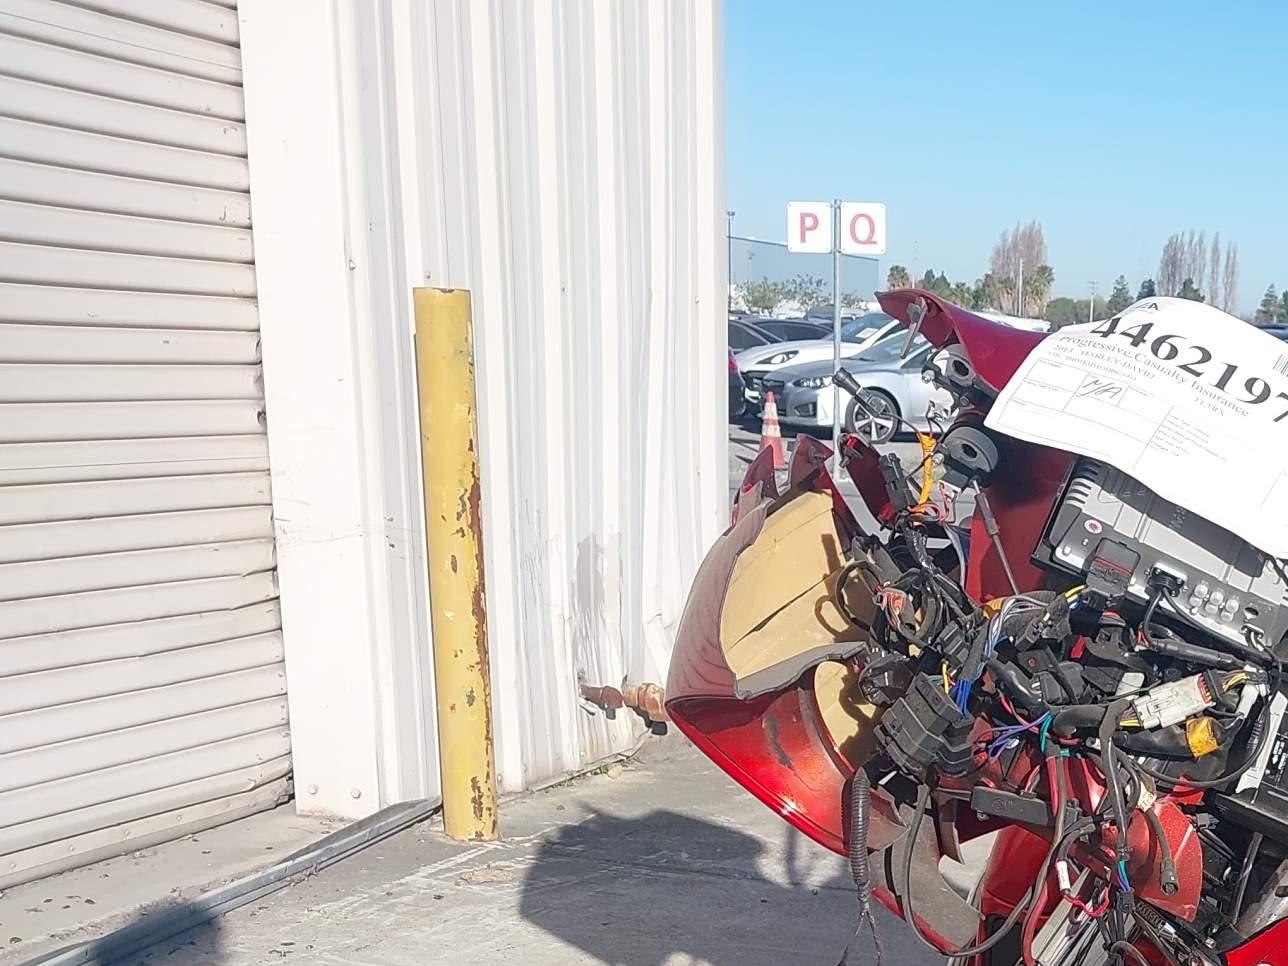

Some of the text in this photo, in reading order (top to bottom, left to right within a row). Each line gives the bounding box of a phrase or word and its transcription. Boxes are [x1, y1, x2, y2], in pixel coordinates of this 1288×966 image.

[799, 212, 819, 243] P
[849, 213, 877, 245] Q
[1059, 336, 1133, 361] Progressive
[1134, 353, 1189, 384] Casualty
[1191, 381, 1250, 417] Insurance
